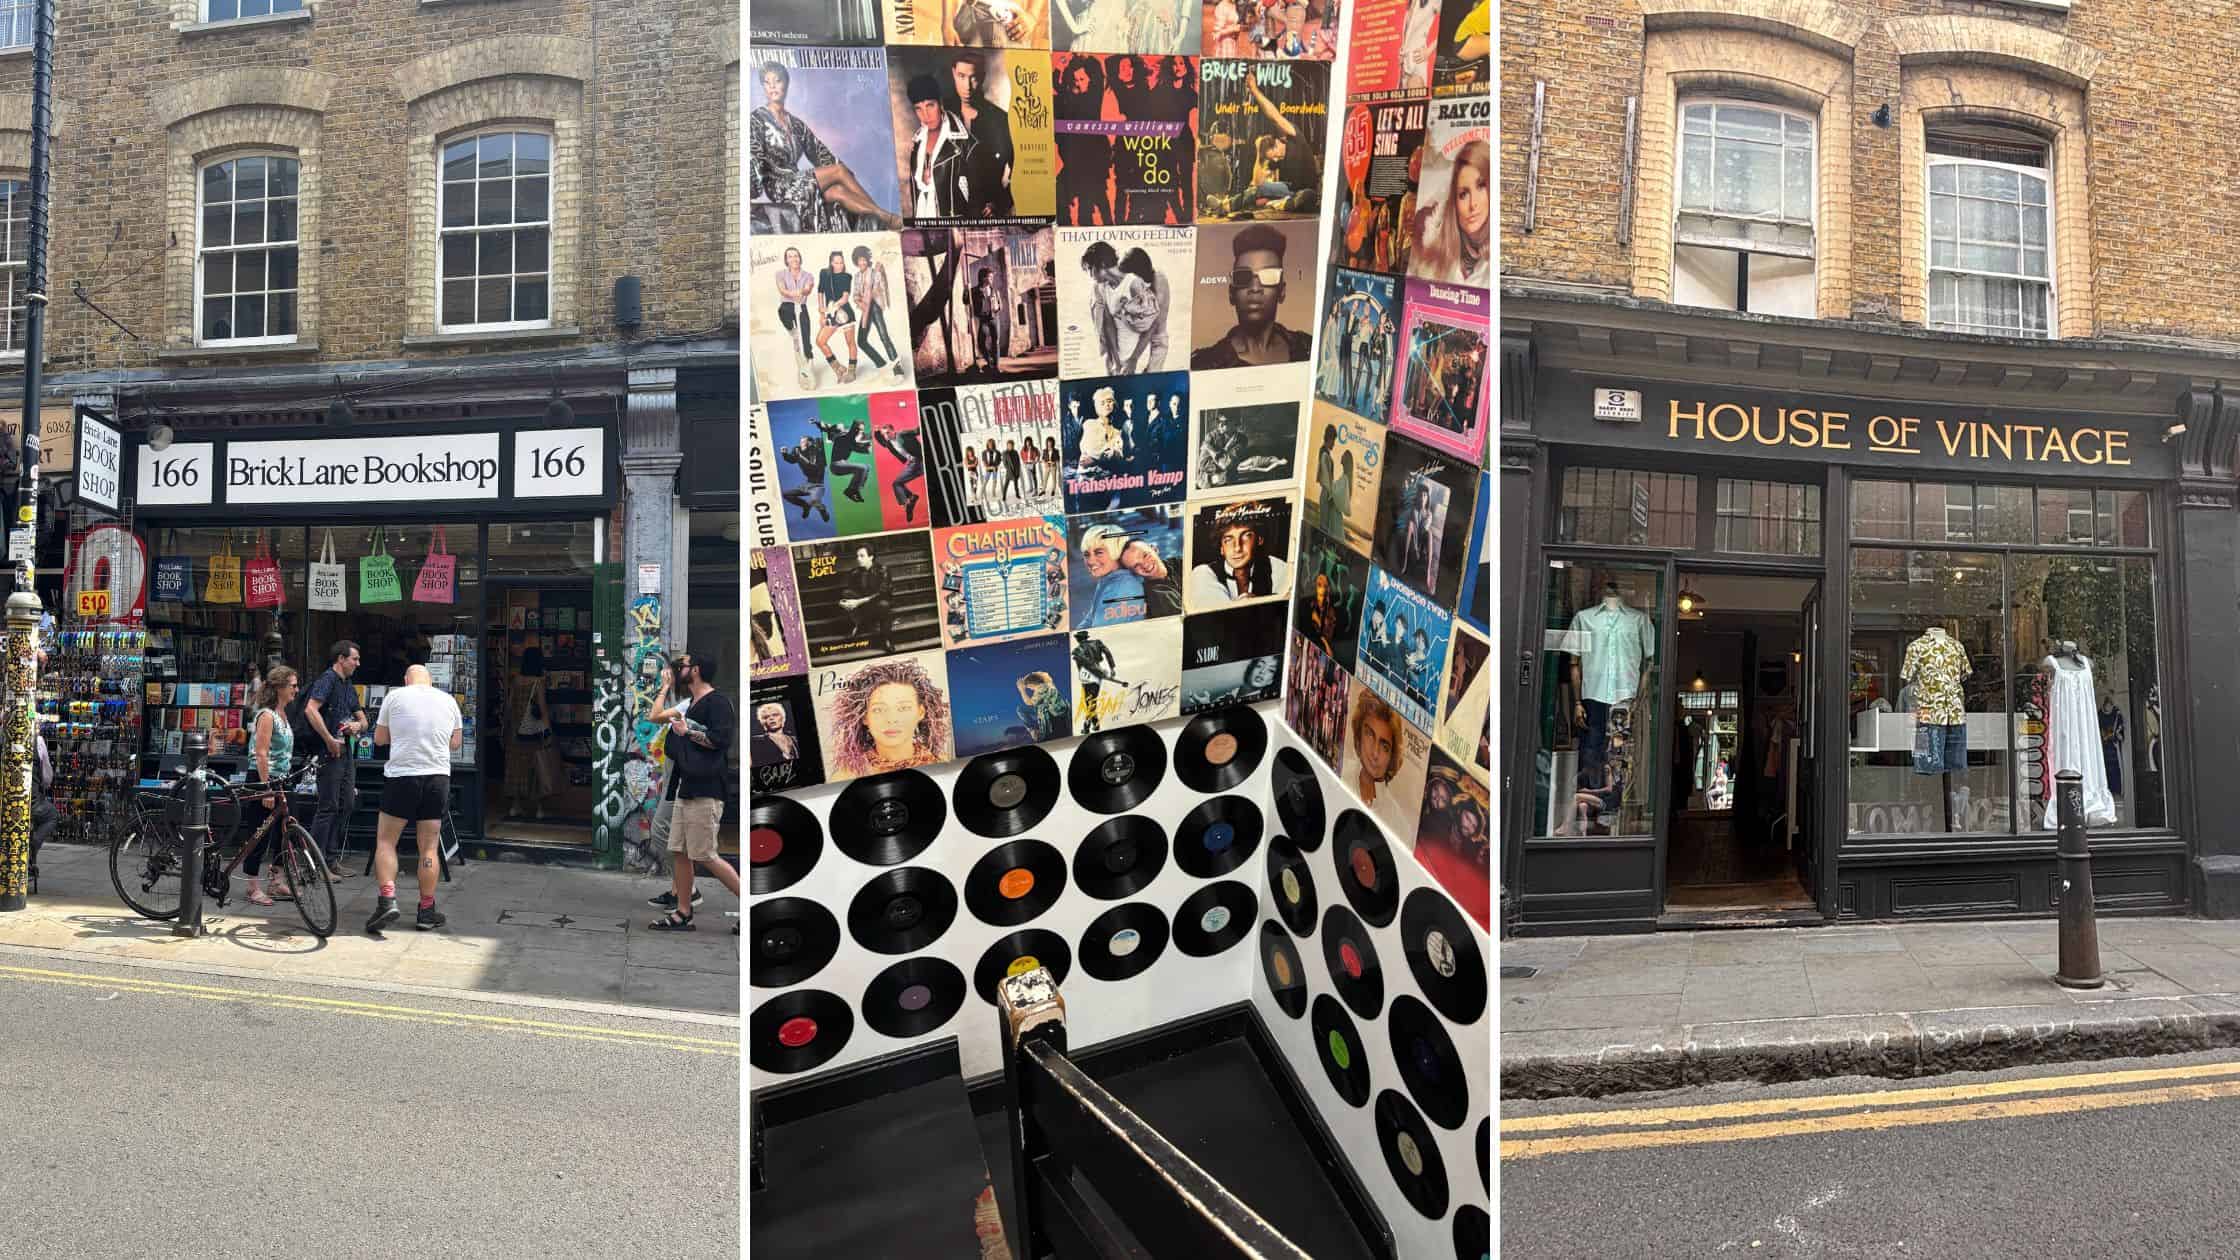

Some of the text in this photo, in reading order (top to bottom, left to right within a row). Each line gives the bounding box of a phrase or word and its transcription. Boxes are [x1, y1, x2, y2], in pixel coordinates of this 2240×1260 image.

[1202, 62, 1293, 88] BRUCE WILLIS
[1013, 105, 1049, 129] Heart
[1216, 101, 1327, 115] Under The Boardwalk
[1376, 105, 1424, 131] LET'S ALL
[1438, 104, 1469, 120] RAY
[1123, 131, 1172, 151] work
[1374, 132, 1399, 156] SING
[1137, 148, 1157, 168] to
[1144, 166, 1170, 184] do
[1094, 230, 1141, 241] LOVING
[1143, 229, 1193, 241] FEELING
[1200, 276, 1227, 285] ADEVA
[1430, 283, 1481, 306] Dancing Time
[83, 421, 118, 449] Brick Lane
[1668, 400, 2131, 465] HOUSE OF VINTAGE
[83, 440, 116, 473] BOOK
[531, 445, 585, 478] 166
[152, 457, 199, 487] 166
[228, 451, 497, 488] Brick Lane Bookshop
[750, 446, 767, 495] SOUL
[82, 471, 116, 499] SHOP
[1066, 469, 1184, 496] Transvision Vamp
[755, 502, 776, 547] CLUB
[808, 565, 837, 579] JOEL
[811, 555, 837, 569] BILLY
[157, 571, 182, 581] BOOK
[252, 573, 275, 586] BOOK
[315, 578, 339, 588] BOOK
[367, 569, 393, 579] BOOK
[367, 577, 393, 589] SHOP
[157, 580, 182, 590] SHOP
[252, 582, 277, 595] SHOP
[314, 588, 339, 598] SHOP
[421, 579, 448, 590] SHOP
[81, 594, 106, 610] £10
[1103, 600, 1147, 622] adieu
[1129, 681, 1179, 715] JONES
